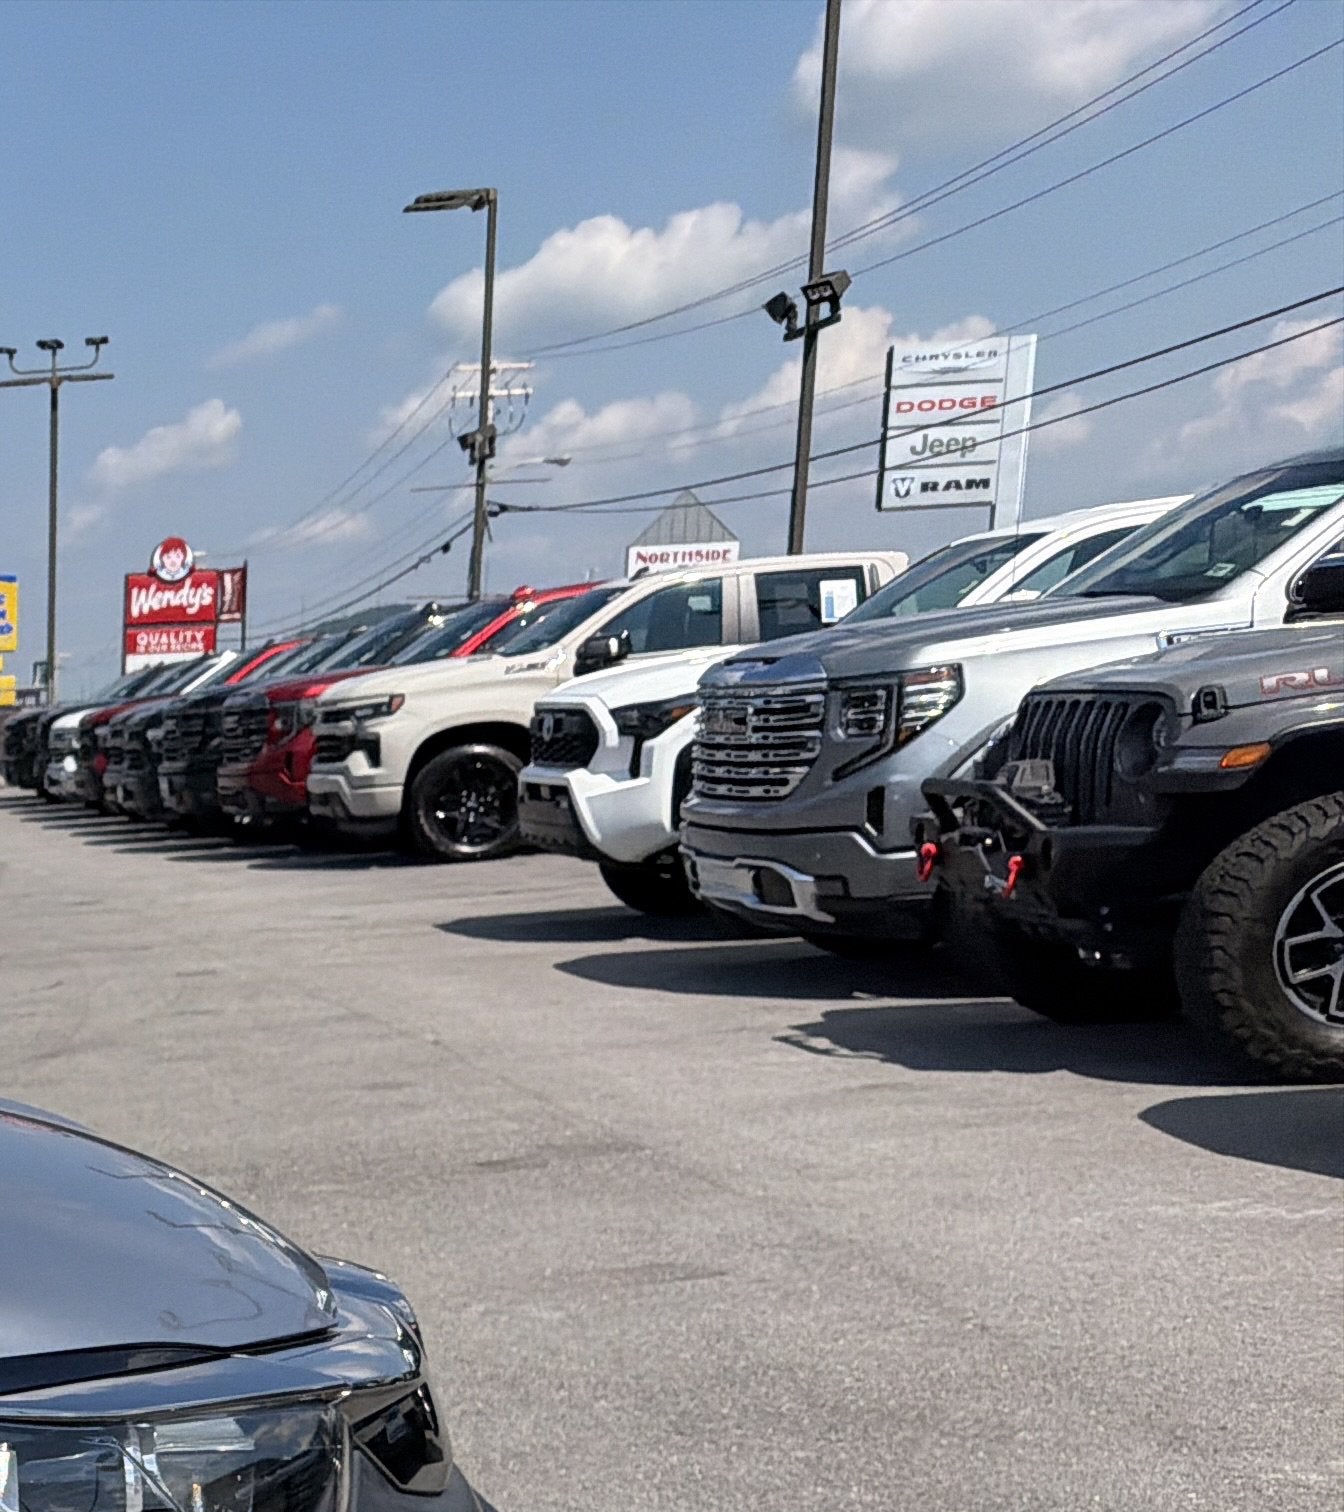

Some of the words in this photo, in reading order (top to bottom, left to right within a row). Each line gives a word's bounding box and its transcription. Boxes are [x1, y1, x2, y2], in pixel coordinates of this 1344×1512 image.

[901, 350, 998, 363] CHRYSLER
[895, 395, 998, 414] DODGE
[909, 433, 977, 458] Jeep
[919, 477, 991, 493] RAM
[636, 550, 731, 565] NORTHSIDE
[131, 577, 215, 618] Wendy's
[136, 631, 204, 646] QUALITY
